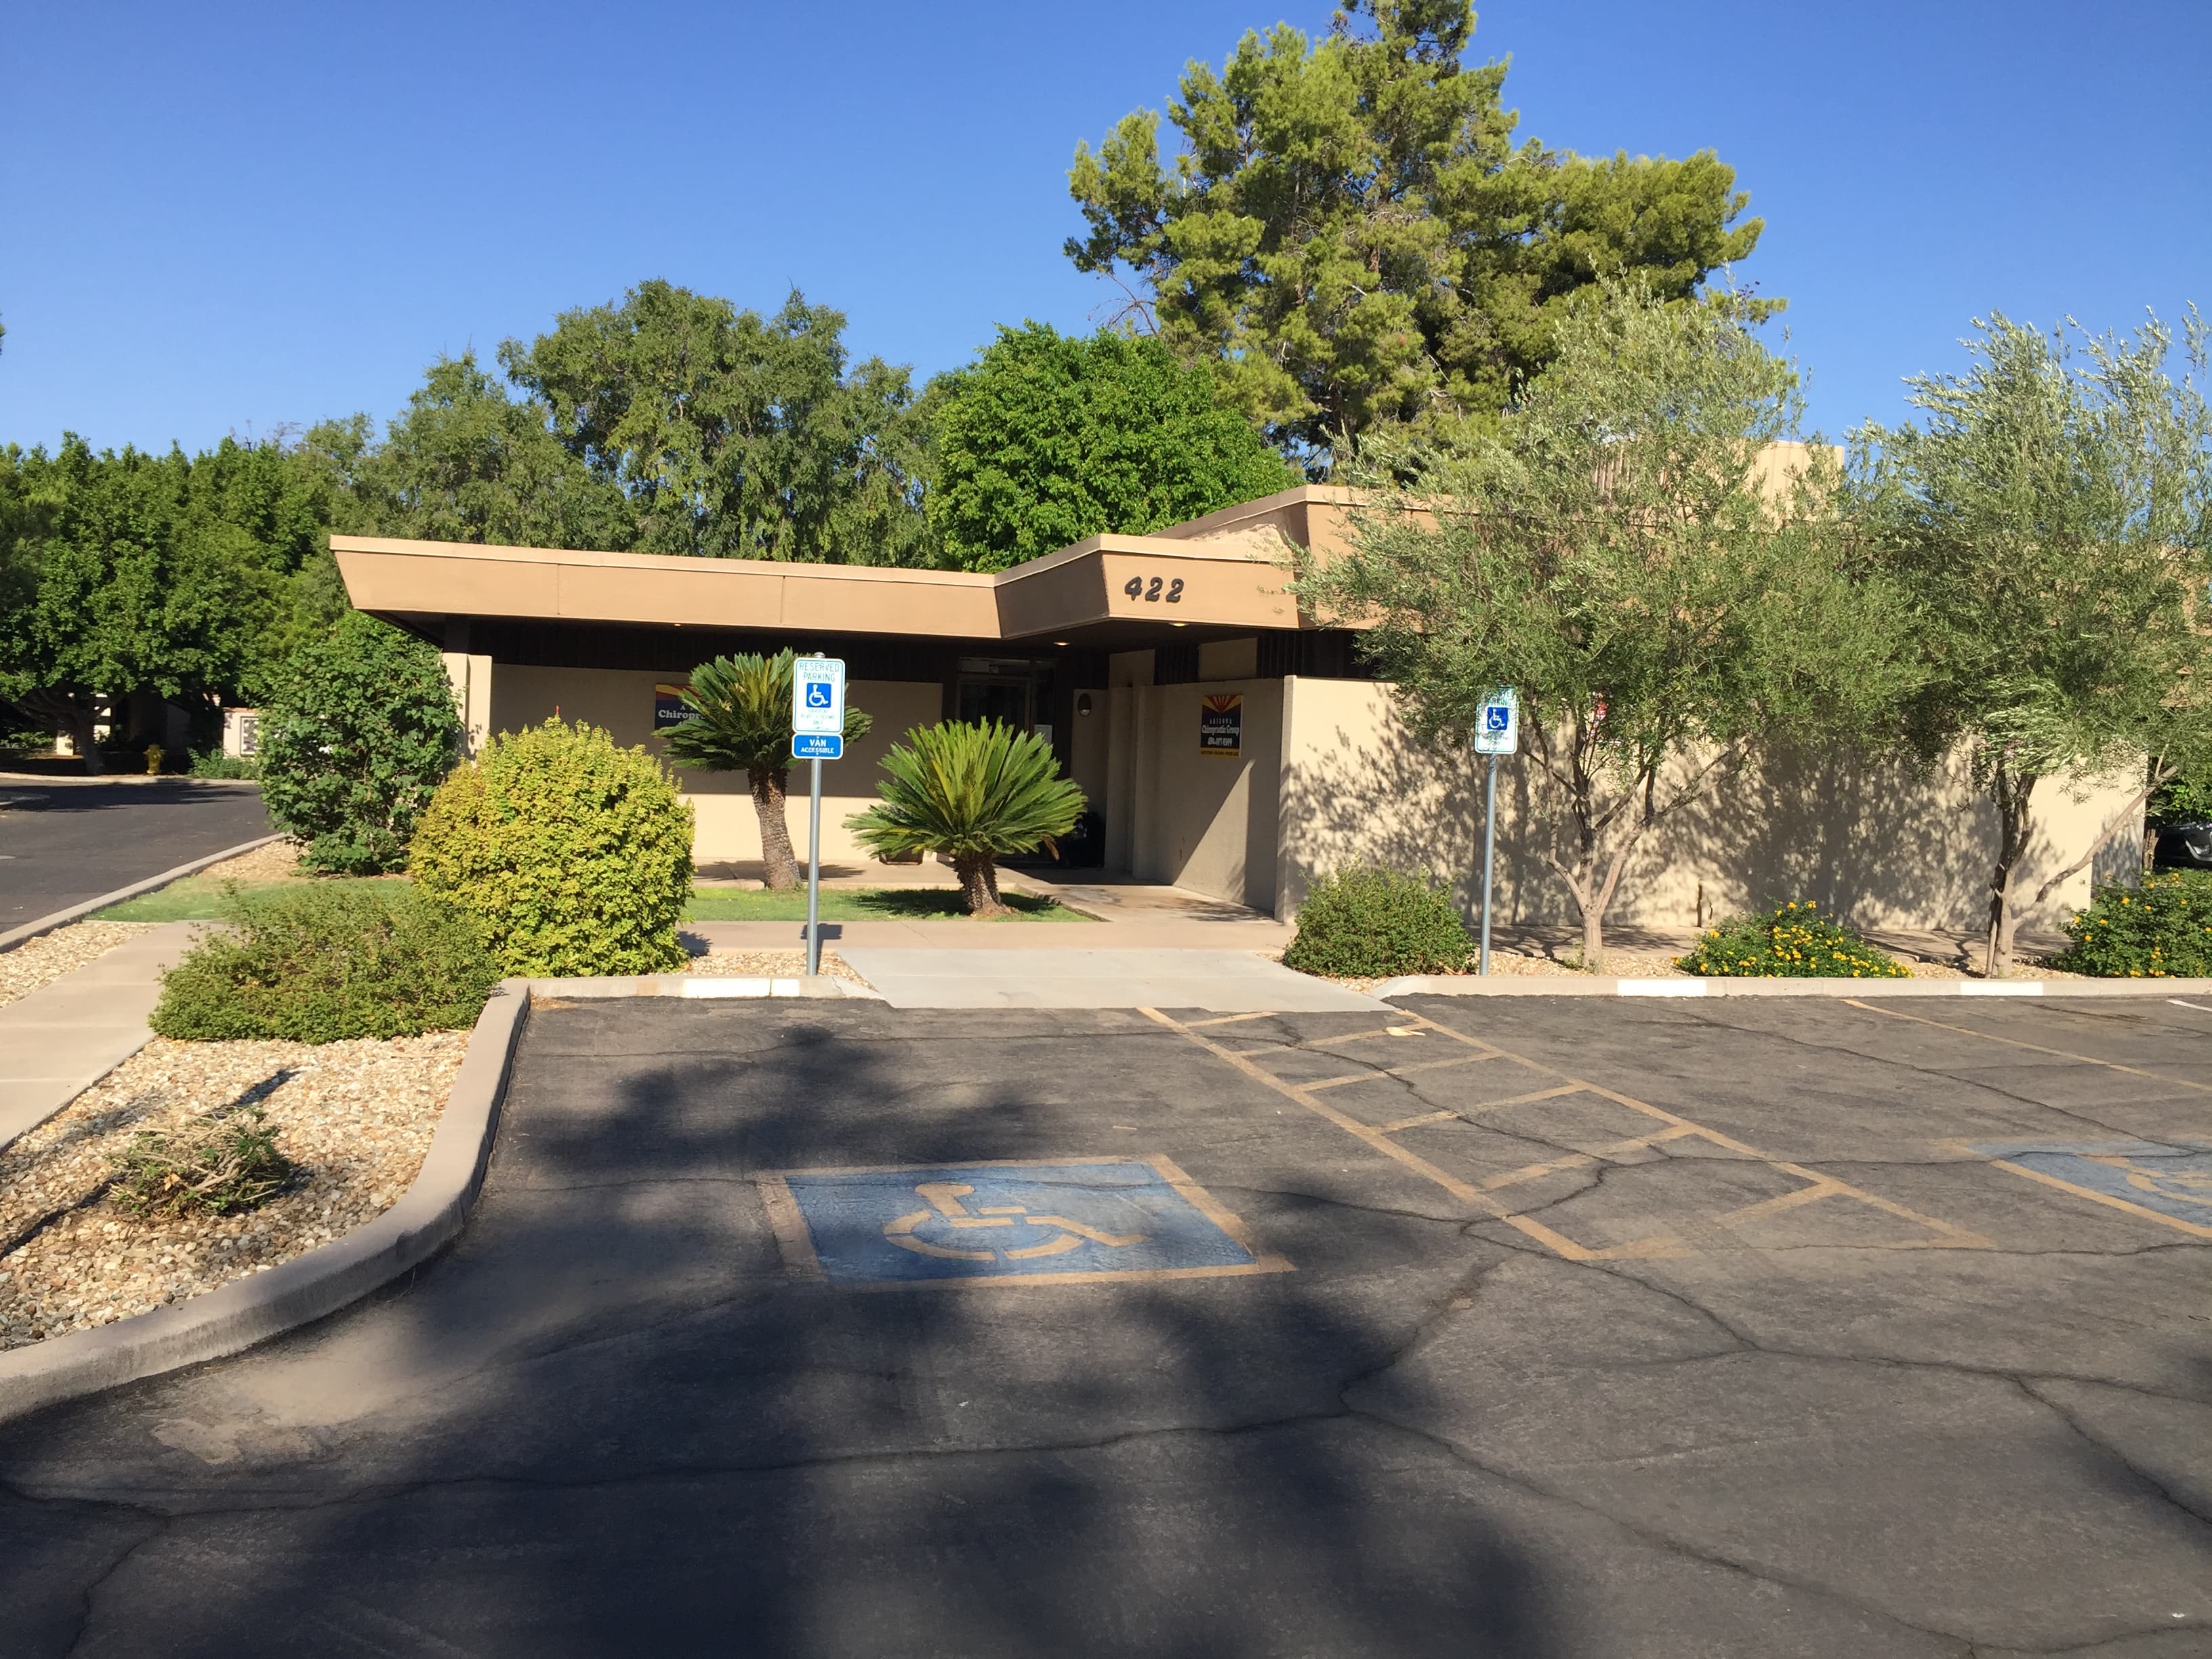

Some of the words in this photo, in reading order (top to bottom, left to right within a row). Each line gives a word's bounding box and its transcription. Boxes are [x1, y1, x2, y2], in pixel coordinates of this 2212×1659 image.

[1124, 576, 1185, 604] 422
[799, 662, 840, 672] RESERVED
[803, 672, 836, 682] PARKING
[809, 739, 827, 747] VAN
